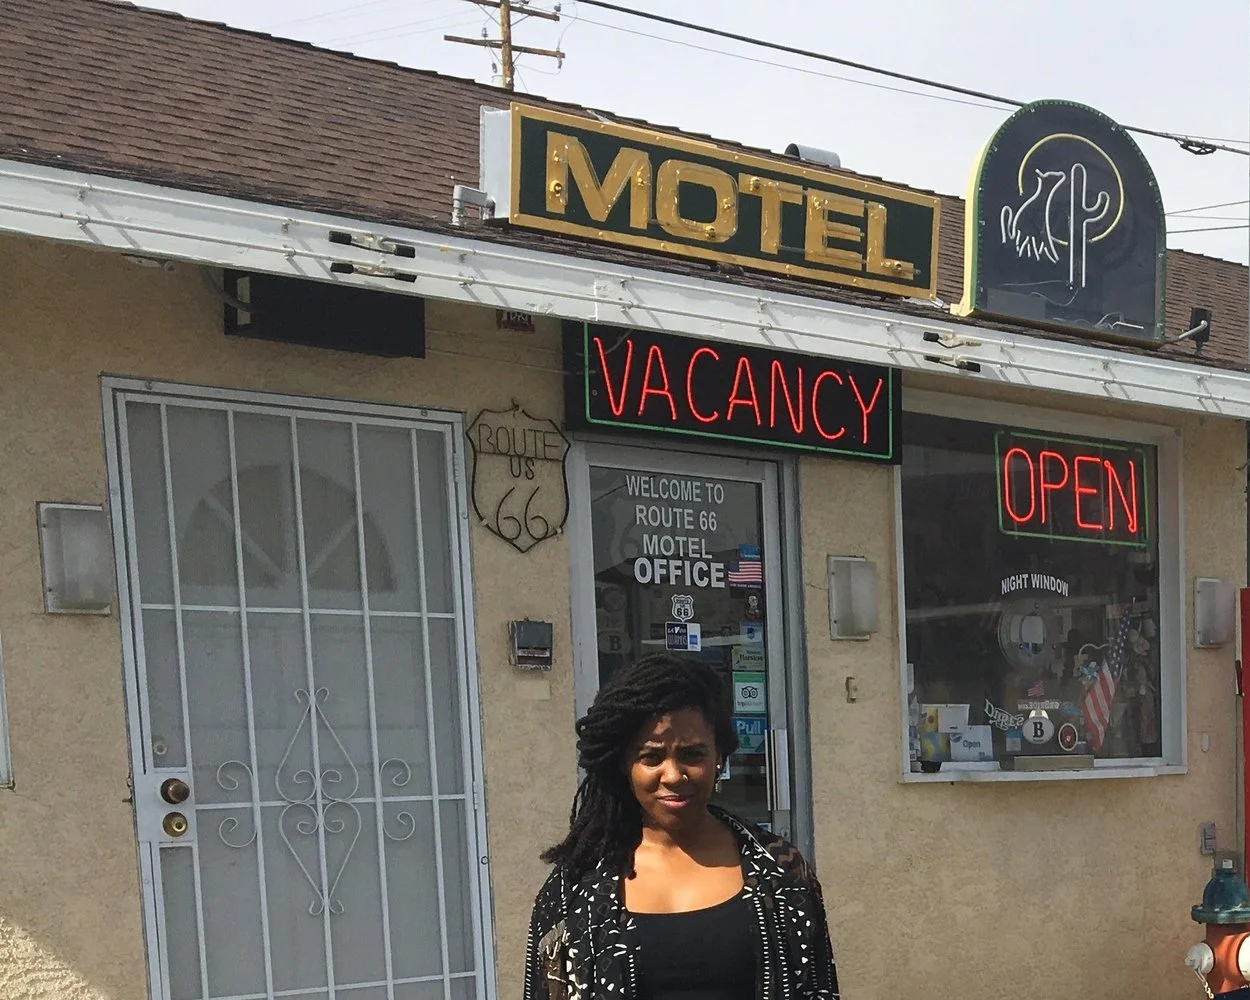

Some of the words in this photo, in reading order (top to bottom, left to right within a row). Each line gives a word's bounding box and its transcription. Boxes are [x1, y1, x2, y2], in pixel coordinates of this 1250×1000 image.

[546, 131, 915, 280] MOTEL
[593, 337, 883, 444] VACANCY
[478, 424, 560, 460] ROUTE
[510, 457, 534, 480] US
[626, 475, 701, 502] WELCOME
[705, 482, 724, 504] TO
[1004, 448, 1137, 533] OPEN
[496, 486, 549, 541] 66
[636, 505, 694, 529] ROUTE
[700, 511, 717, 531] 66
[643, 534, 712, 559] MOTEL
[634, 557, 726, 588] OFFICE
[1001, 574, 1028, 595] NIGHT
[1031, 573, 1069, 597] WINDOW
[677, 608, 689, 617] 66
[736, 721, 760, 734] Pull
[1033, 721, 1045, 738] B
[963, 740, 981, 750] Open
